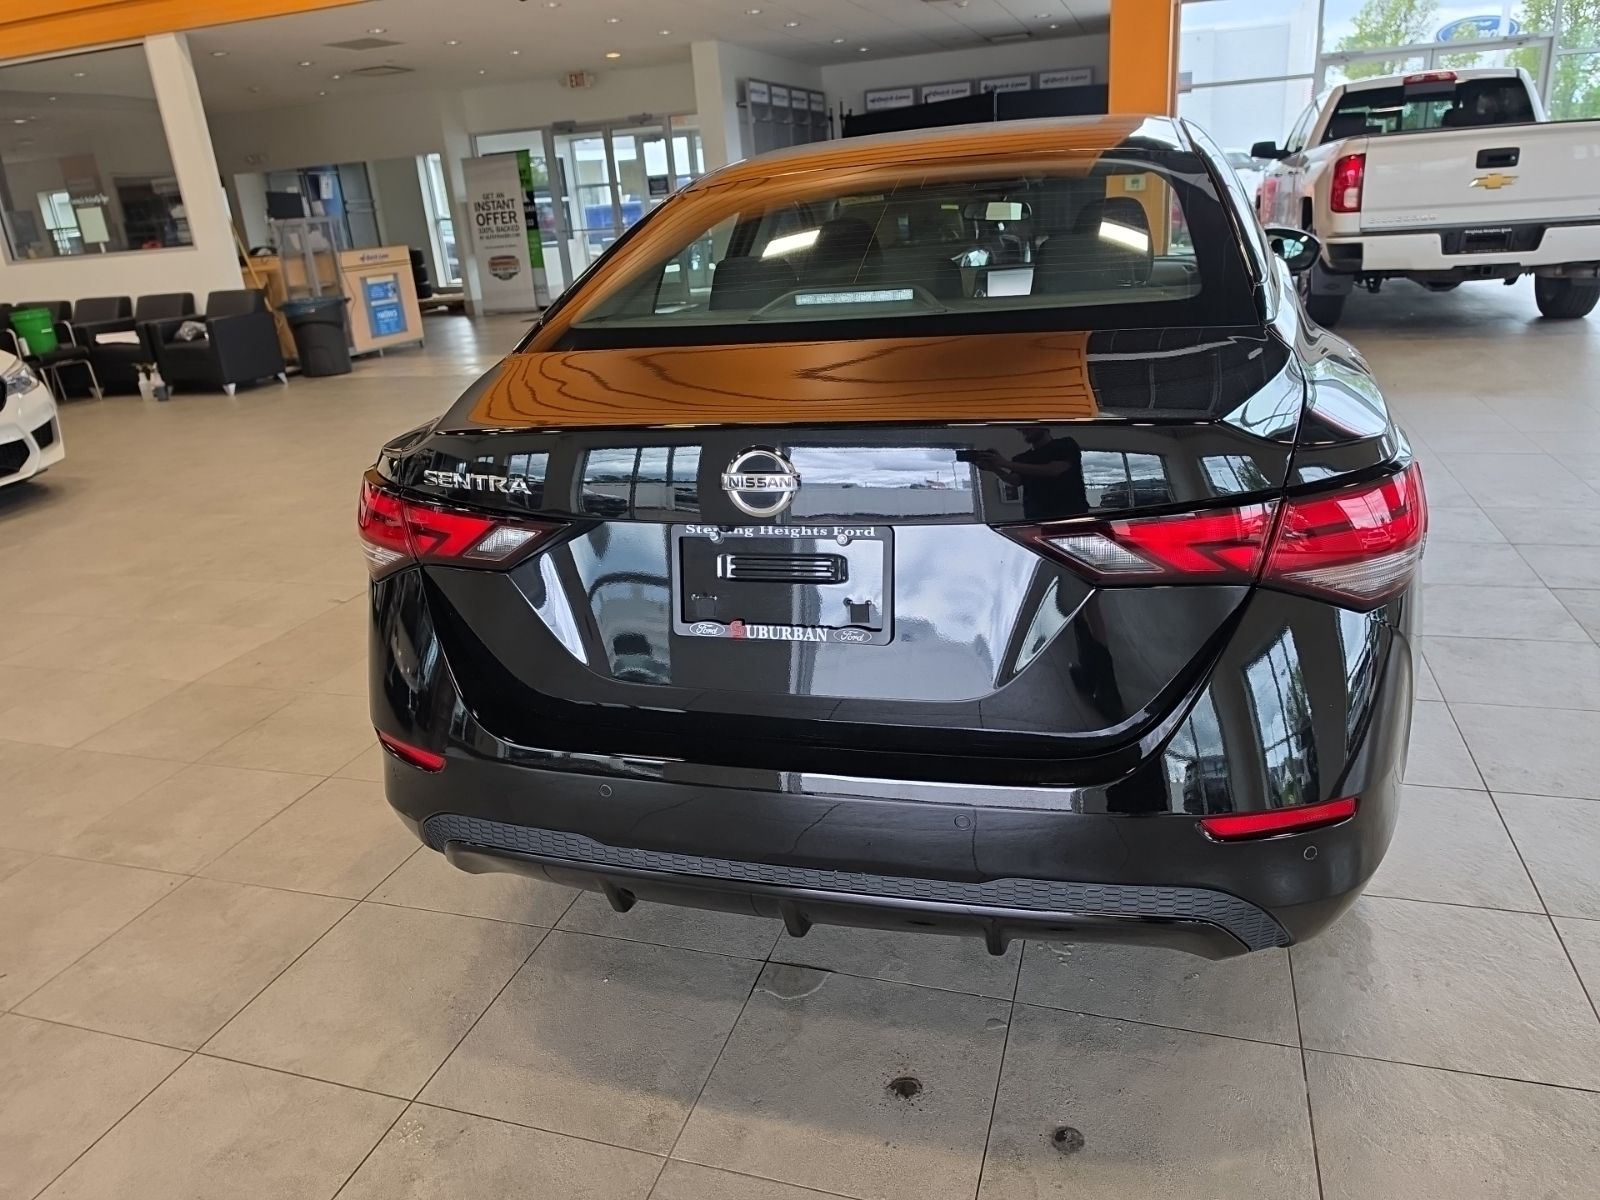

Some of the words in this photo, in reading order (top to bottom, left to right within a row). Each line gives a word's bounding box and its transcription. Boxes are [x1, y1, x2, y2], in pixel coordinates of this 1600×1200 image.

[482, 192, 495, 200] GET
[474, 198, 516, 213] INSTANT
[476, 210, 518, 226] OFFER
[423, 469, 533, 495] SENTRA
[728, 474, 793, 490] NISSAN
[685, 524, 755, 538] Sterng
[759, 525, 828, 538] Heights
[832, 526, 876, 537] Ford
[696, 624, 719, 636] Ford
[729, 620, 828, 642] SUBURBAN
[839, 630, 865, 642] Ford
